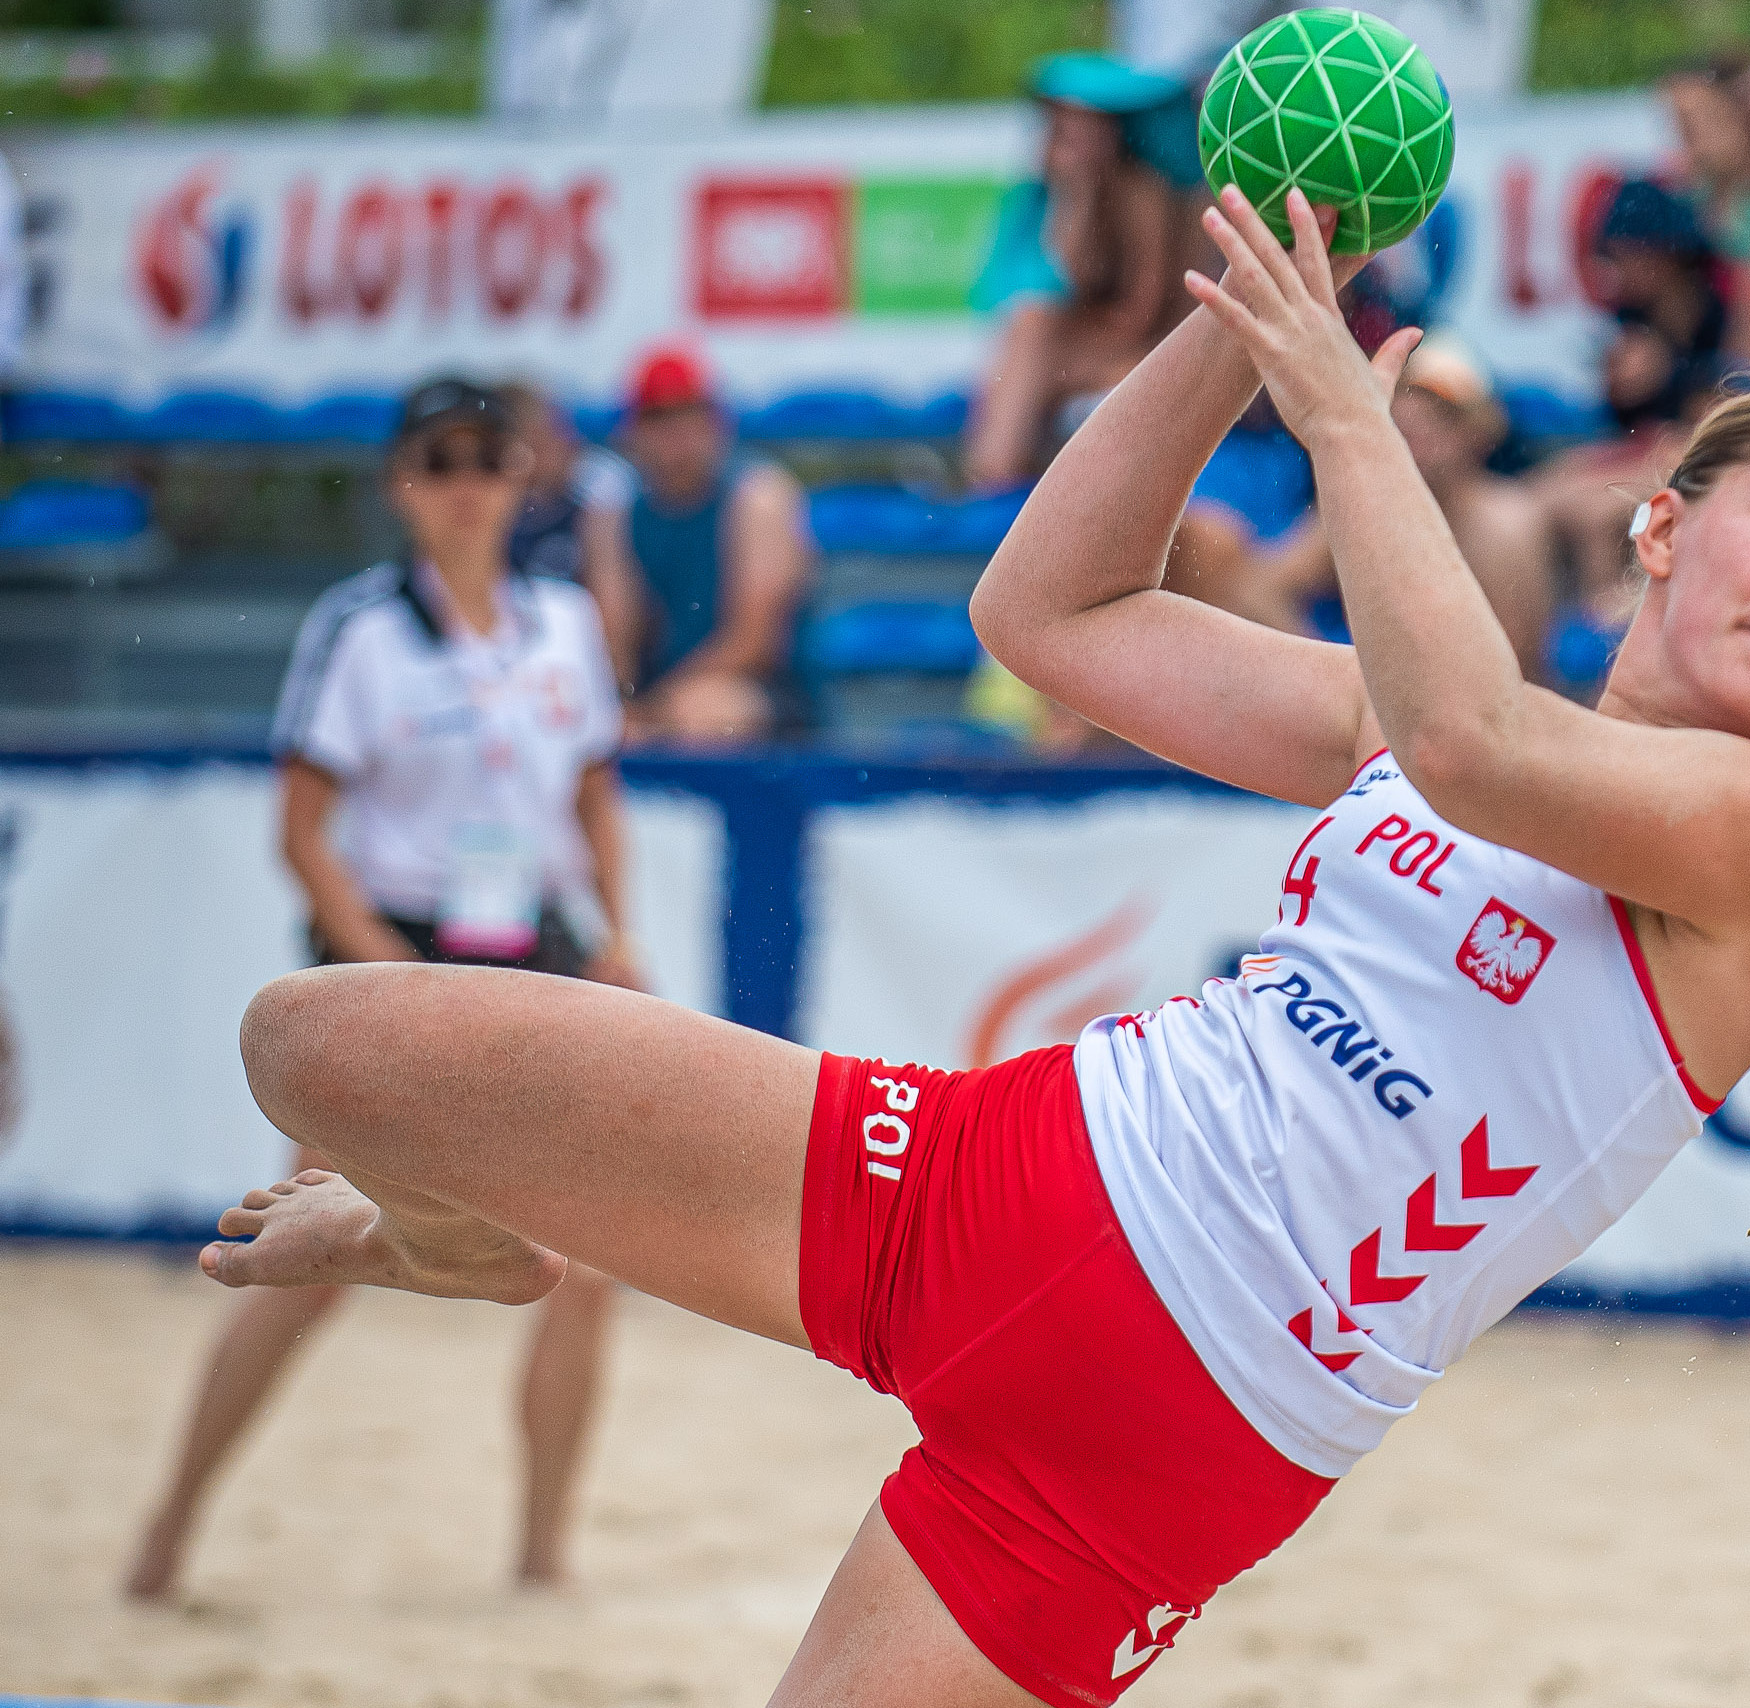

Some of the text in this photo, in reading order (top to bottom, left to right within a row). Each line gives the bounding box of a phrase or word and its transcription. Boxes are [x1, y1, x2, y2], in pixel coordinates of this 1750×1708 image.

[278, 174, 610, 328] LOTOS
[1355, 812, 1458, 897] POL
[1253, 971, 1434, 1120] PGNiG
